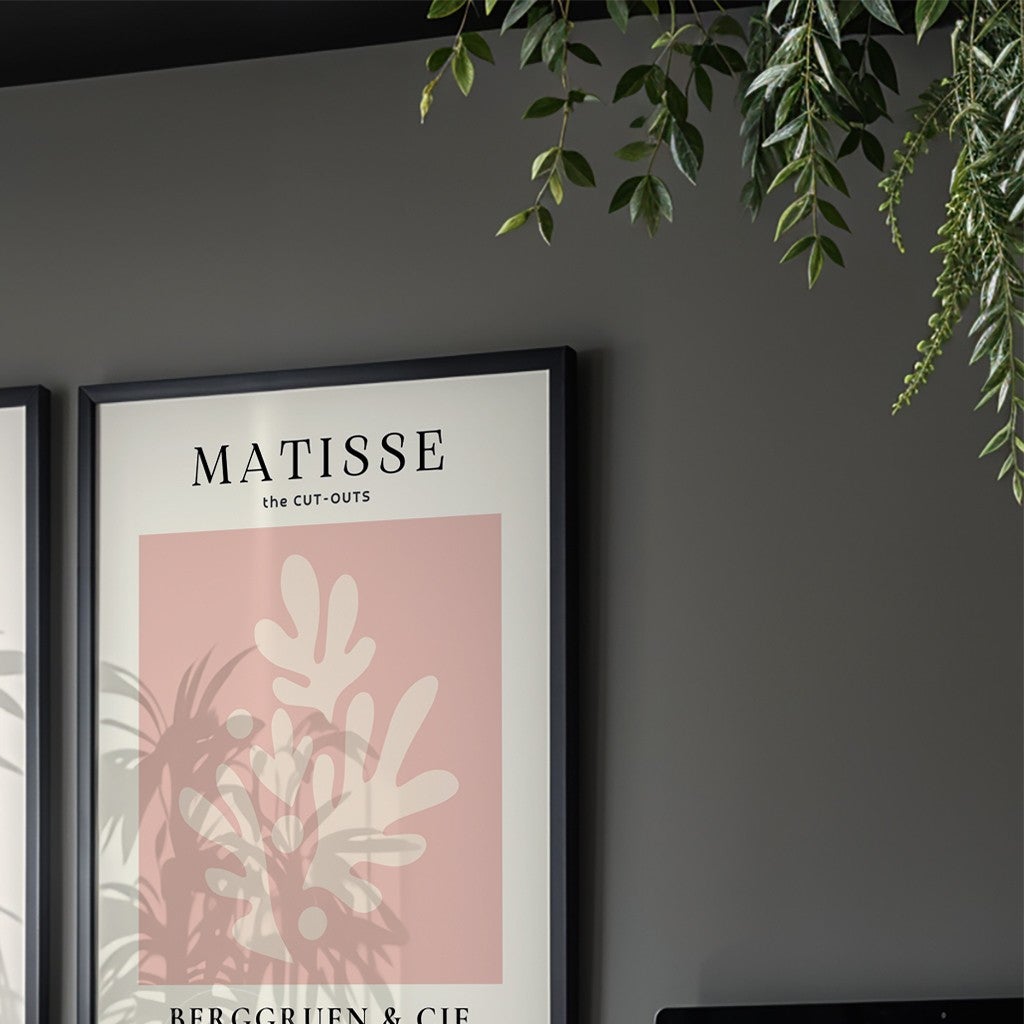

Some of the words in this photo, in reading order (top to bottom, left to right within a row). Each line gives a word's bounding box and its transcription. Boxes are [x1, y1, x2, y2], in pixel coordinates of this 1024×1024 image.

[192, 429, 446, 487] MATISSE
[262, 495, 288, 509] the
[293, 490, 371, 507] CUT-OUTS
